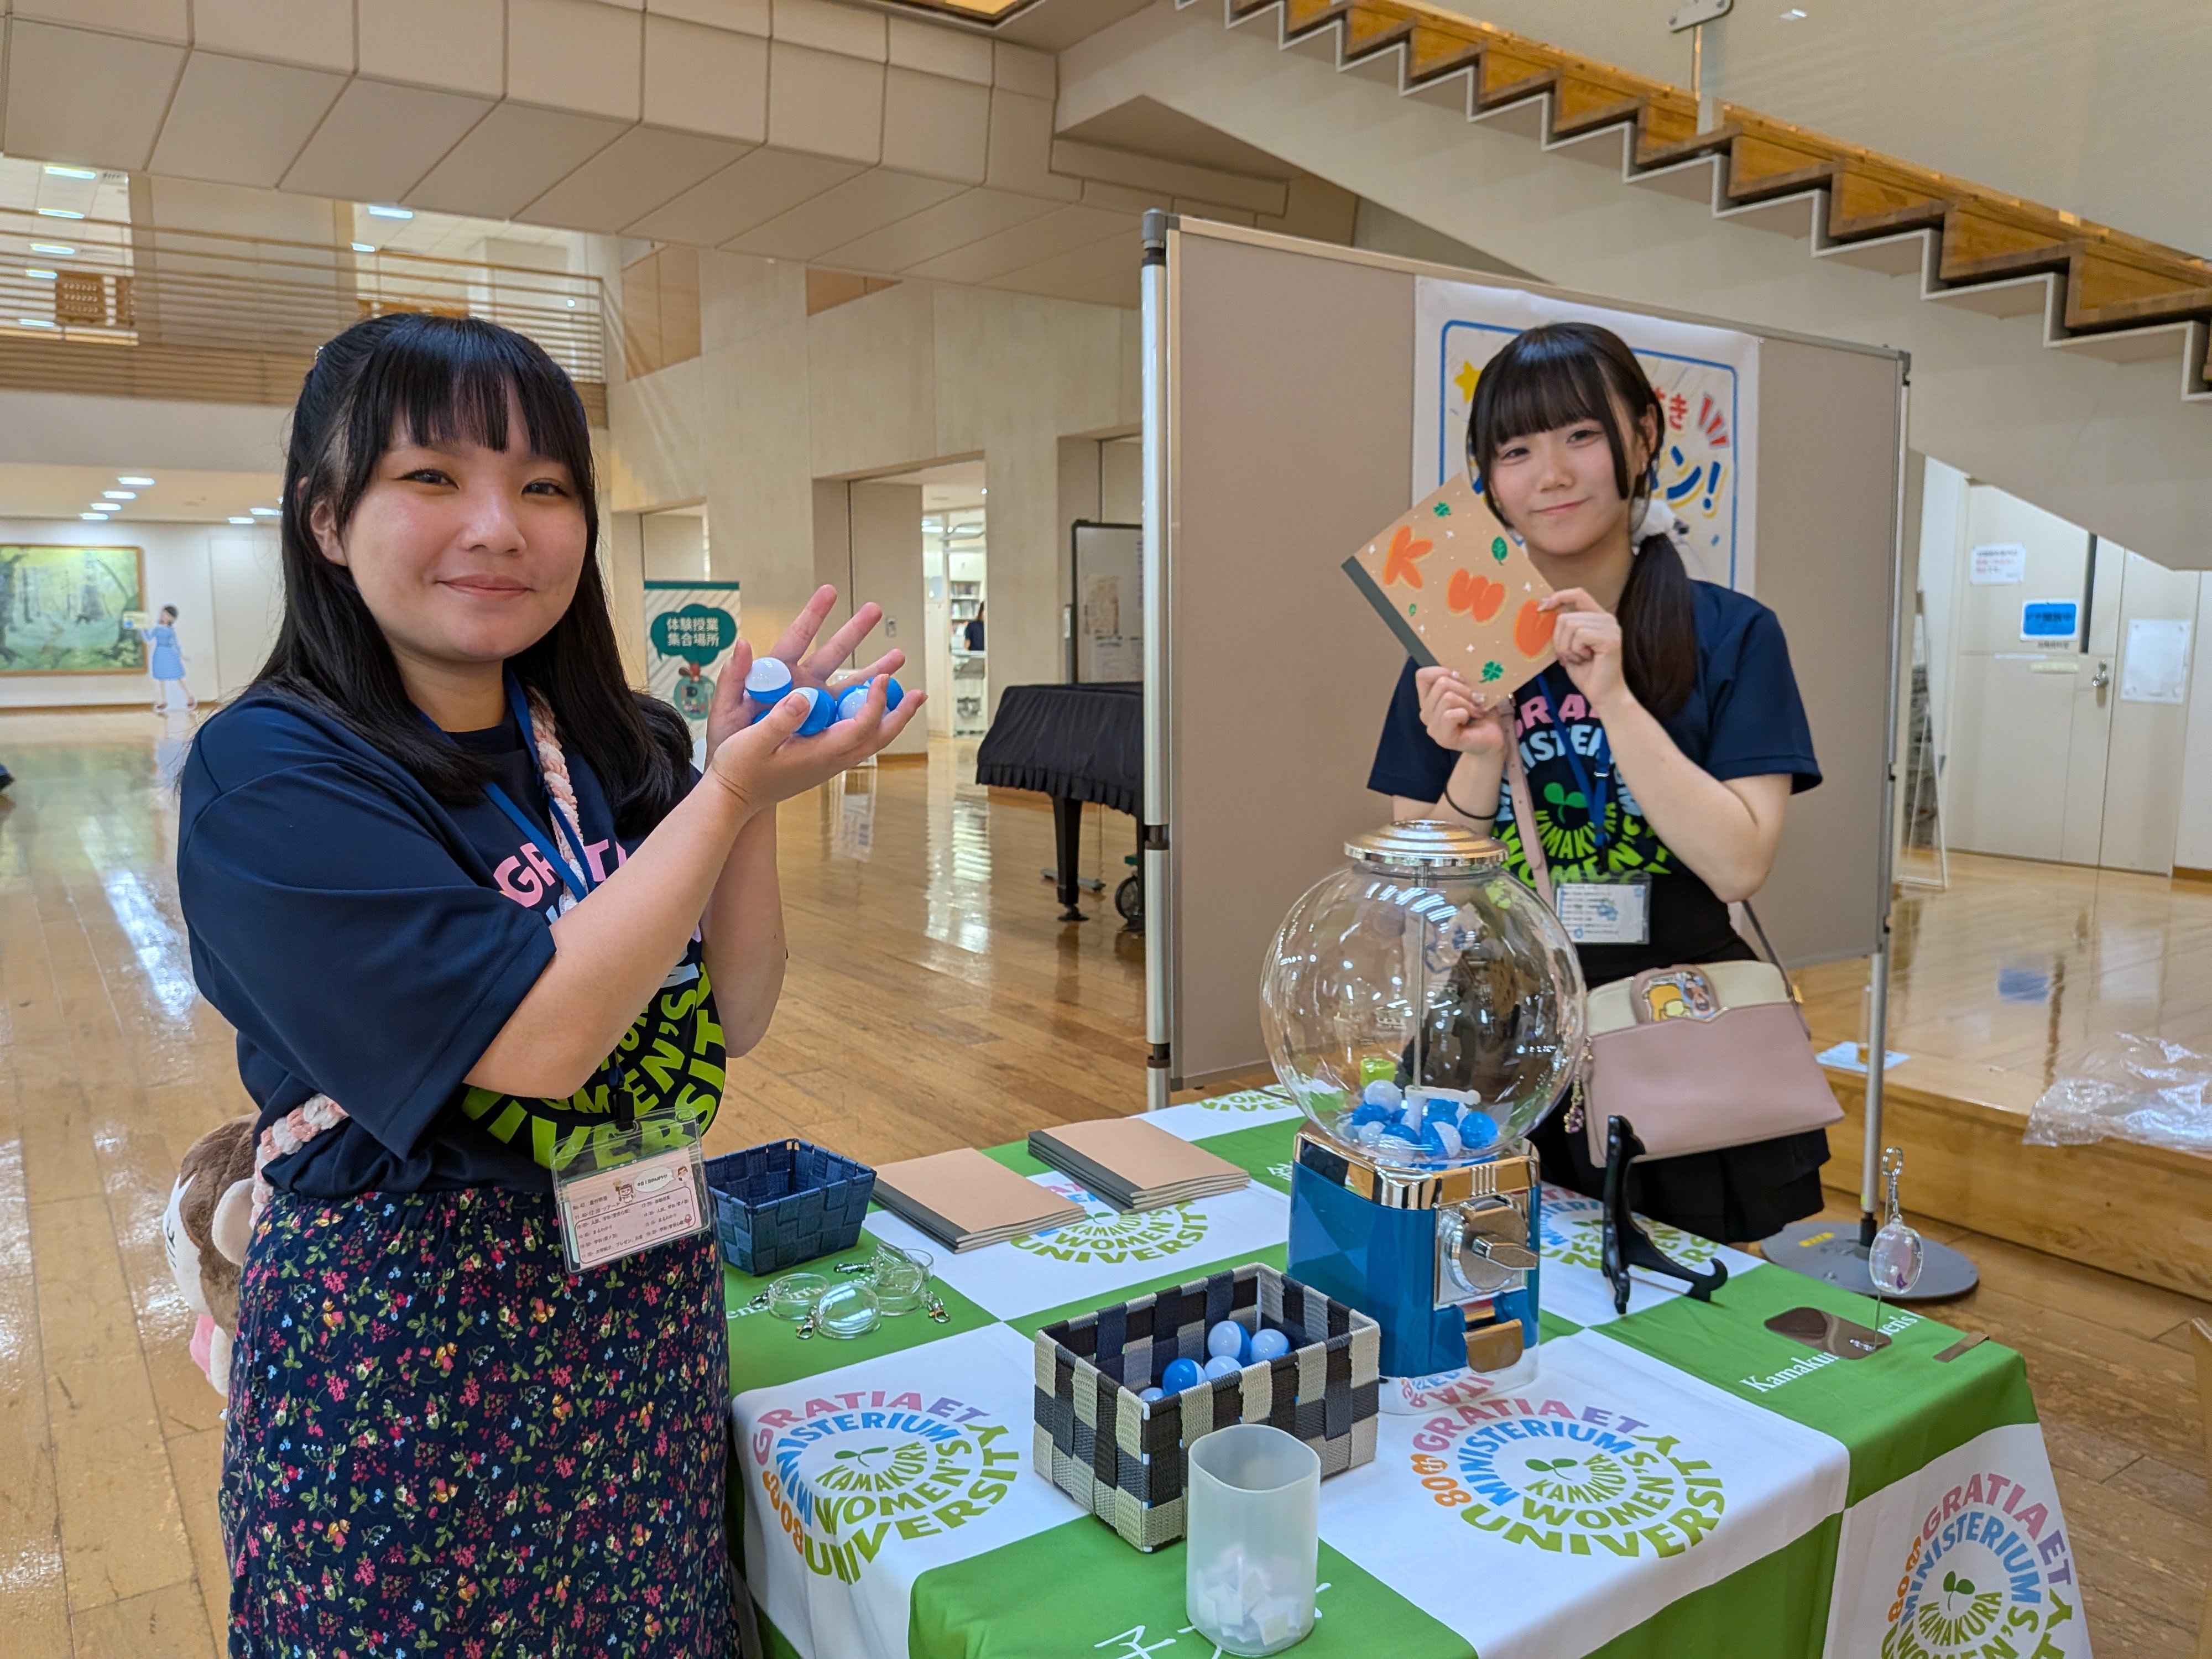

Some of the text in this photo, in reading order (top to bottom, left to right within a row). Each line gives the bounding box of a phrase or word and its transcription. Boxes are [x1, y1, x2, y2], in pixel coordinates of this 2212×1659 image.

[667, 617, 718, 632] 体験授業
[667, 633, 719, 647] 集合場所
[753, 1391, 991, 1465] GRATIA ET
[1413, 1398, 1649, 1452] GRATIA ET
[1457, 1419, 1637, 1507] MINISTERIUM
[775, 1412, 962, 1527] MINISTERIUM
[805, 1423, 1019, 1585] UNIVERSITY
[815, 1441, 928, 1492] KAMAKURA
[815, 1439, 973, 1535] WOMEN'S
[1460, 1434, 1725, 1558] UNIVERSITY
[1522, 1451, 1675, 1529] WOMEN'S
[1524, 1453, 1627, 1504] KAMAKURA
[1923, 1473, 2072, 1585] GRATIA ET
[1901, 1511, 2041, 1628] MINISTERIUM
[1919, 1592, 2002, 1646] KAMAKURA
